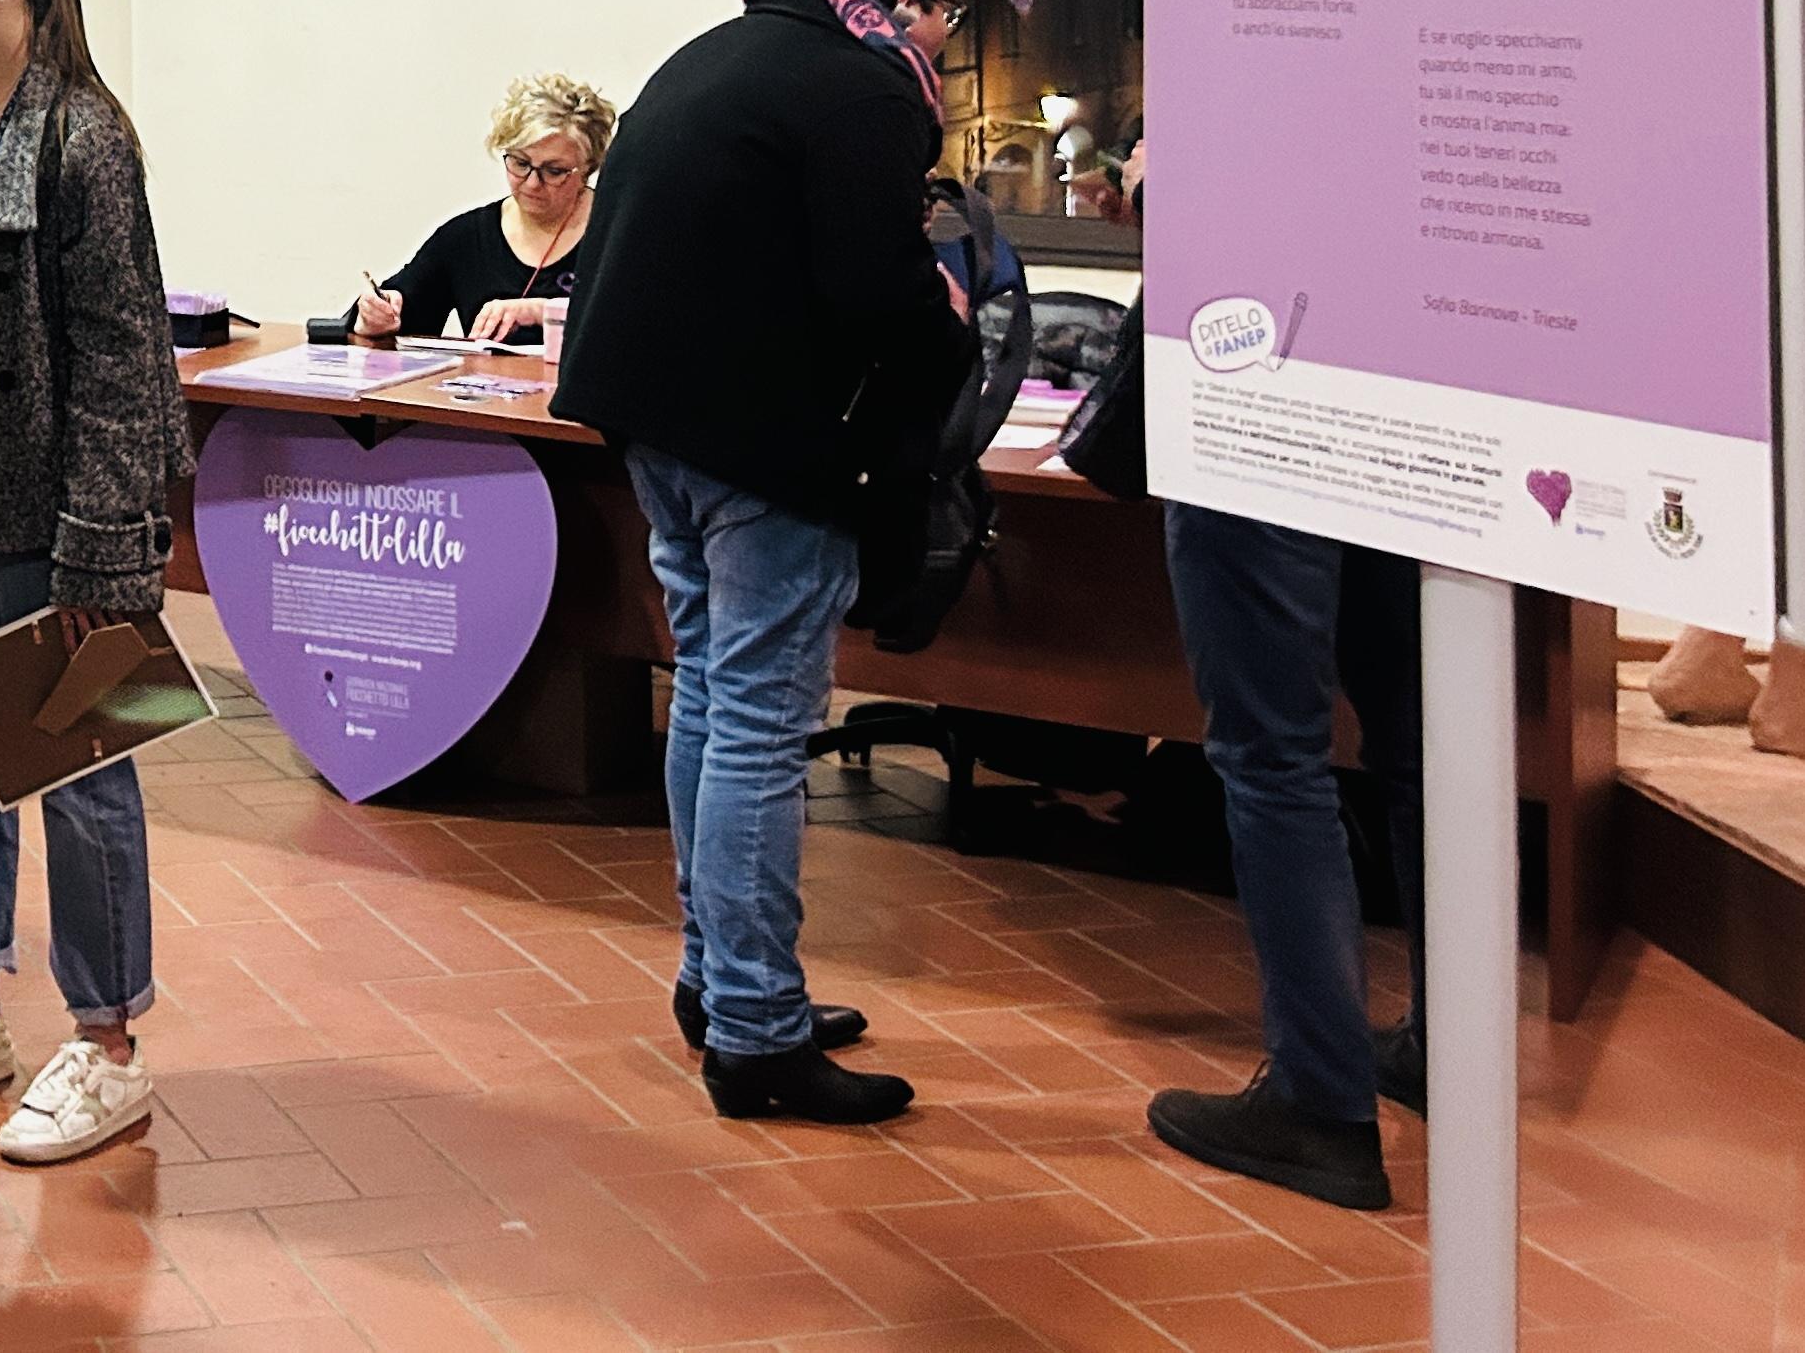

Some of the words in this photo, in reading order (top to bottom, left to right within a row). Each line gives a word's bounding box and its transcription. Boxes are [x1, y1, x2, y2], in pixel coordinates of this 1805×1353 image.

[1418, 27, 1428, 44] E
[1430, 32, 1447, 45] se
[1450, 31, 1492, 50] voglio
[1418, 57, 1470, 74] quando
[1473, 61, 1514, 76] meno
[1517, 62, 1535, 77] mi
[1418, 85, 1434, 99] tu
[1466, 88, 1493, 103] mio
[1496, 89, 1560, 107] specchio
[1419, 114, 1428, 128] e
[1431, 114, 1482, 132] mostra
[1443, 142, 1470, 158] tuoi
[1473, 144, 1516, 161] teneri
[1519, 148, 1558, 164] occhi
[1420, 169, 1454, 184] vedo
[1456, 171, 1499, 188] quella
[1502, 173, 1562, 194] bellezza
[1420, 196, 1444, 211] che
[1448, 200, 1495, 217] ricerco
[1498, 204, 1512, 218] in
[1514, 206, 1539, 221] me
[1541, 208, 1591, 227] stessa
[1420, 224, 1430, 237] e
[1432, 225, 1479, 242] ritrovo
[1423, 293, 1457, 314] Sofia
[1533, 308, 1578, 331] Trieste
[1198, 308, 1262, 342] DITELO
[1213, 328, 1266, 357] FANEP
[345, 482, 359, 507] DI
[365, 484, 446, 516] INDOSSARE
[263, 503, 466, 570] #fiocchettolilla
